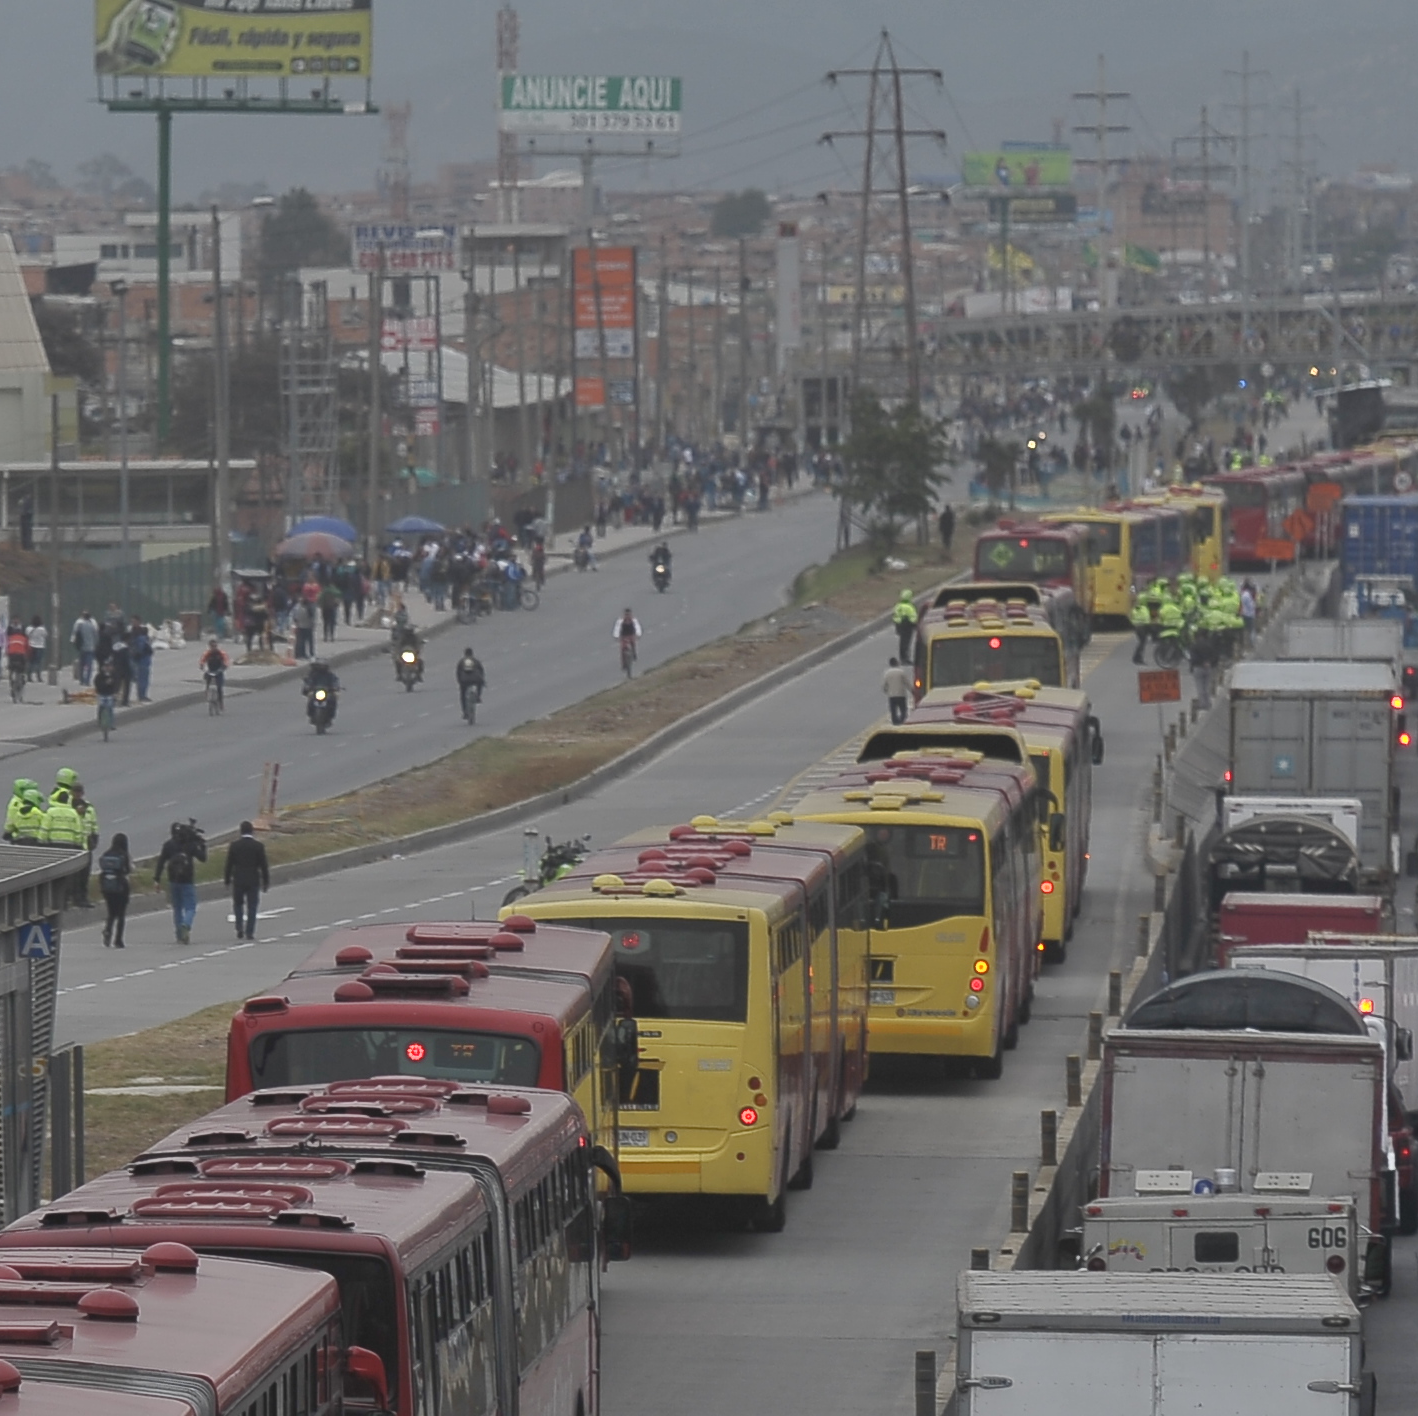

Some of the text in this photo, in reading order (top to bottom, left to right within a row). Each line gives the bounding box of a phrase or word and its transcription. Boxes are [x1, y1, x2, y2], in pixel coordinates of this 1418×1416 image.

[511, 76, 672, 109] ANUNCIE AQUI
[929, 835, 946, 851] TR
[21, 924, 51, 956] A
[1308, 1227, 1347, 1249] 606
